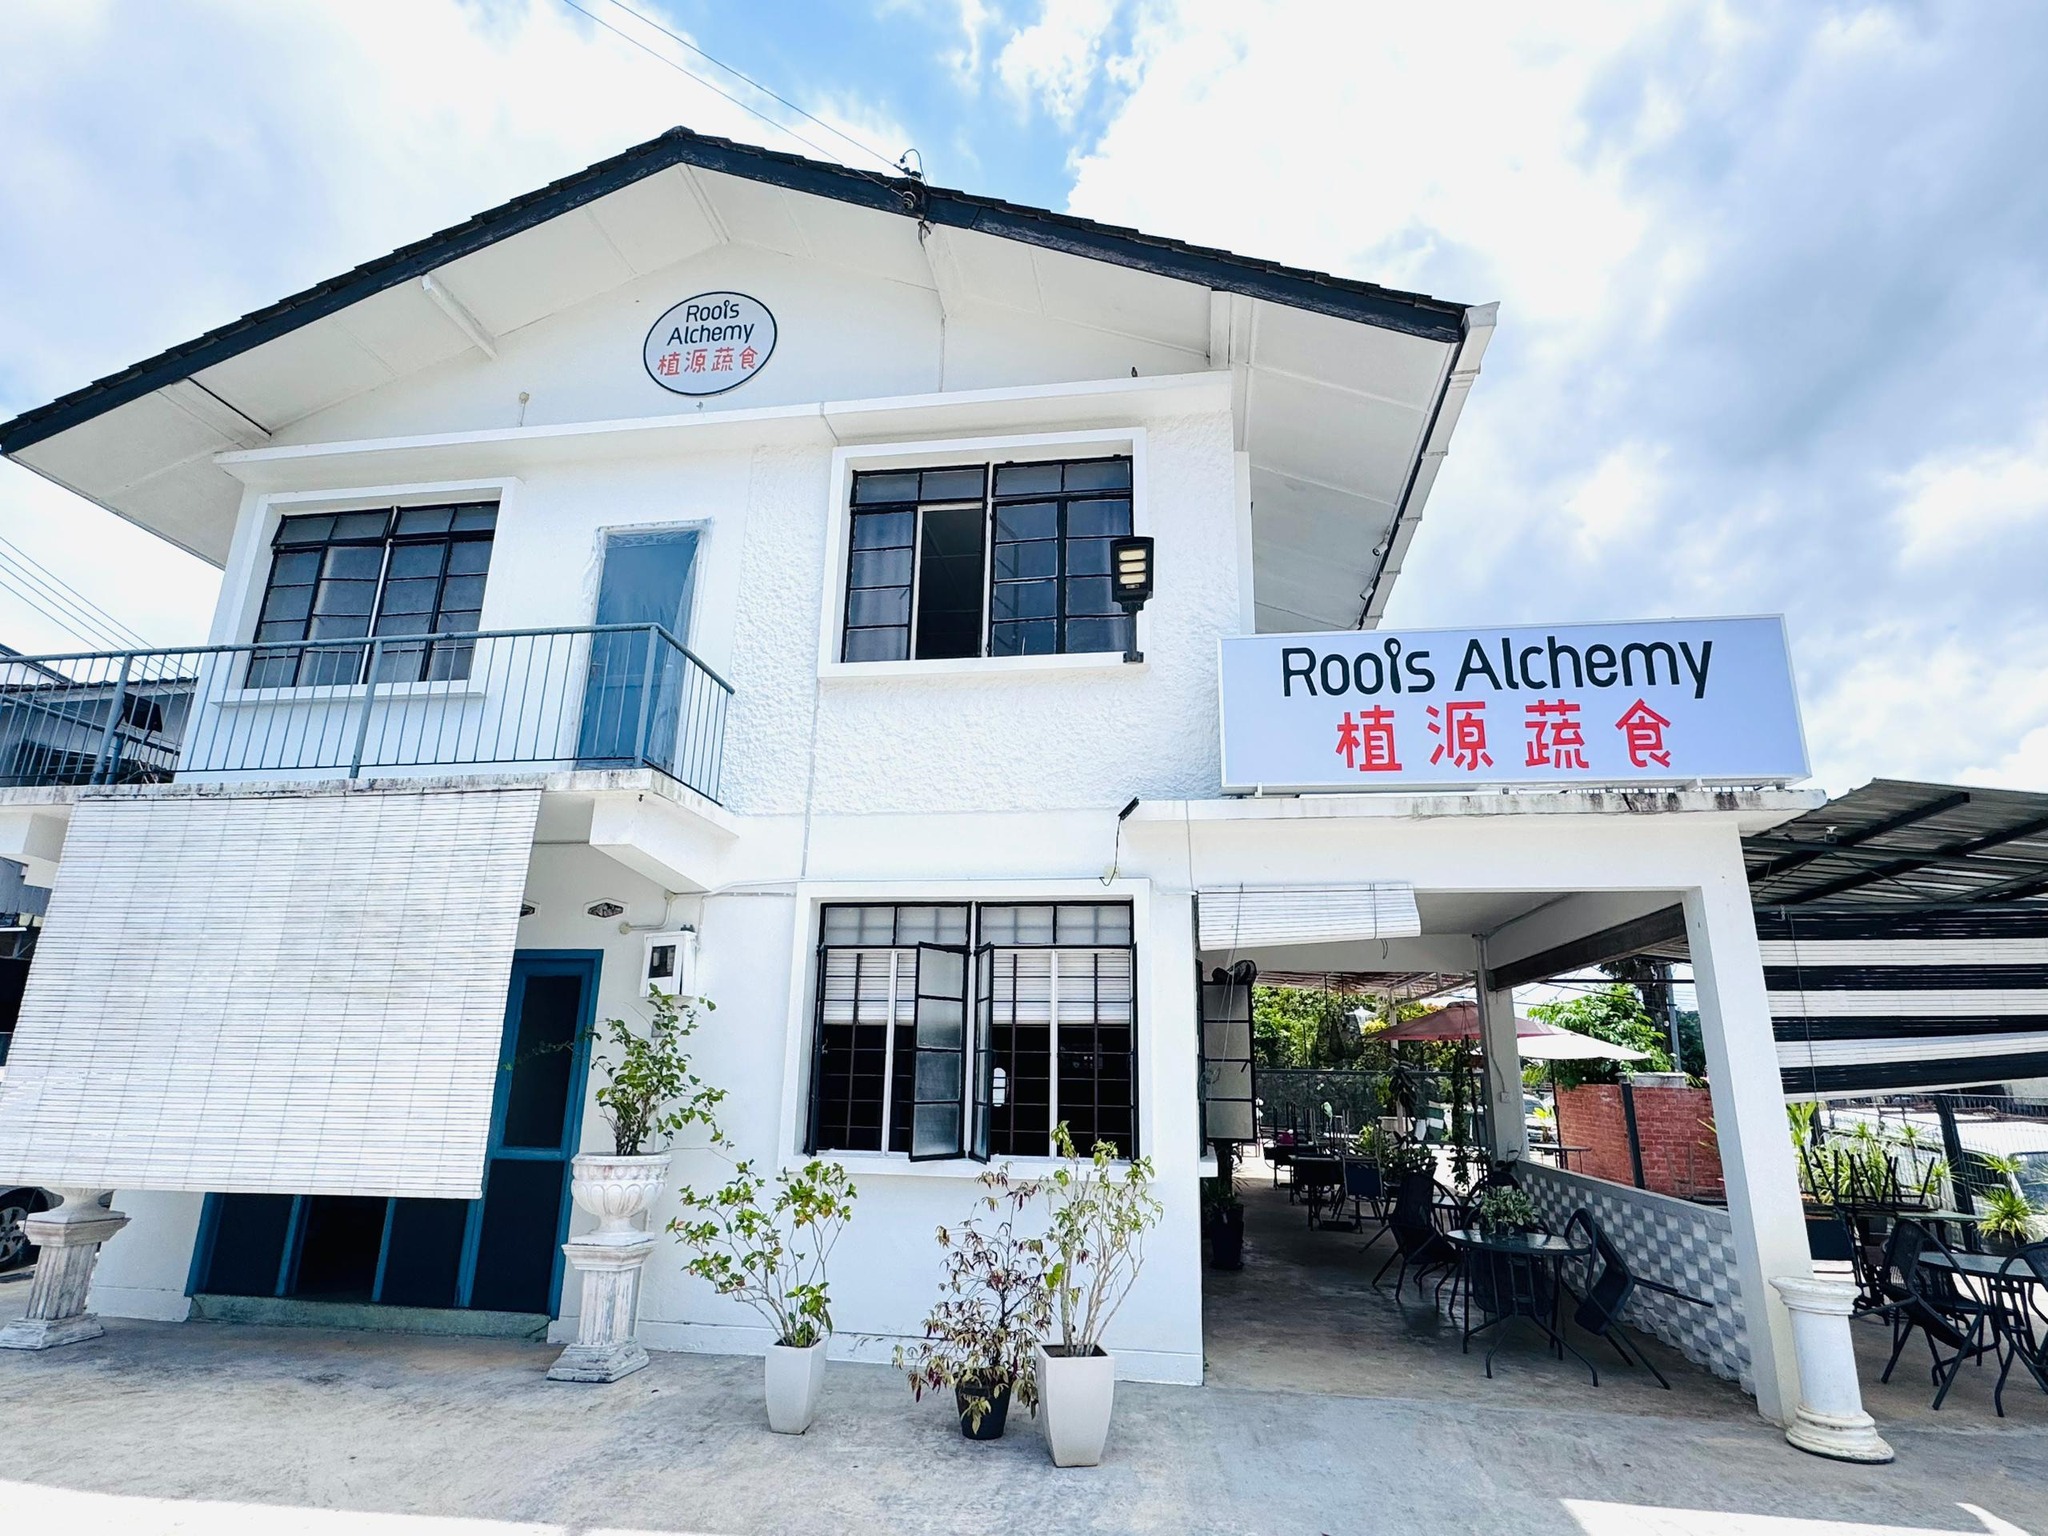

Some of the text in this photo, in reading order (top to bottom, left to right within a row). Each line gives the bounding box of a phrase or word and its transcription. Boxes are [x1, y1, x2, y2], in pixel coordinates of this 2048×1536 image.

[666, 323, 755, 346] Alchemy
[657, 346, 758, 376] 植源蔬食
[1454, 636, 1713, 699] Alchemy
[1335, 699, 1671, 772] 植源蔬食
